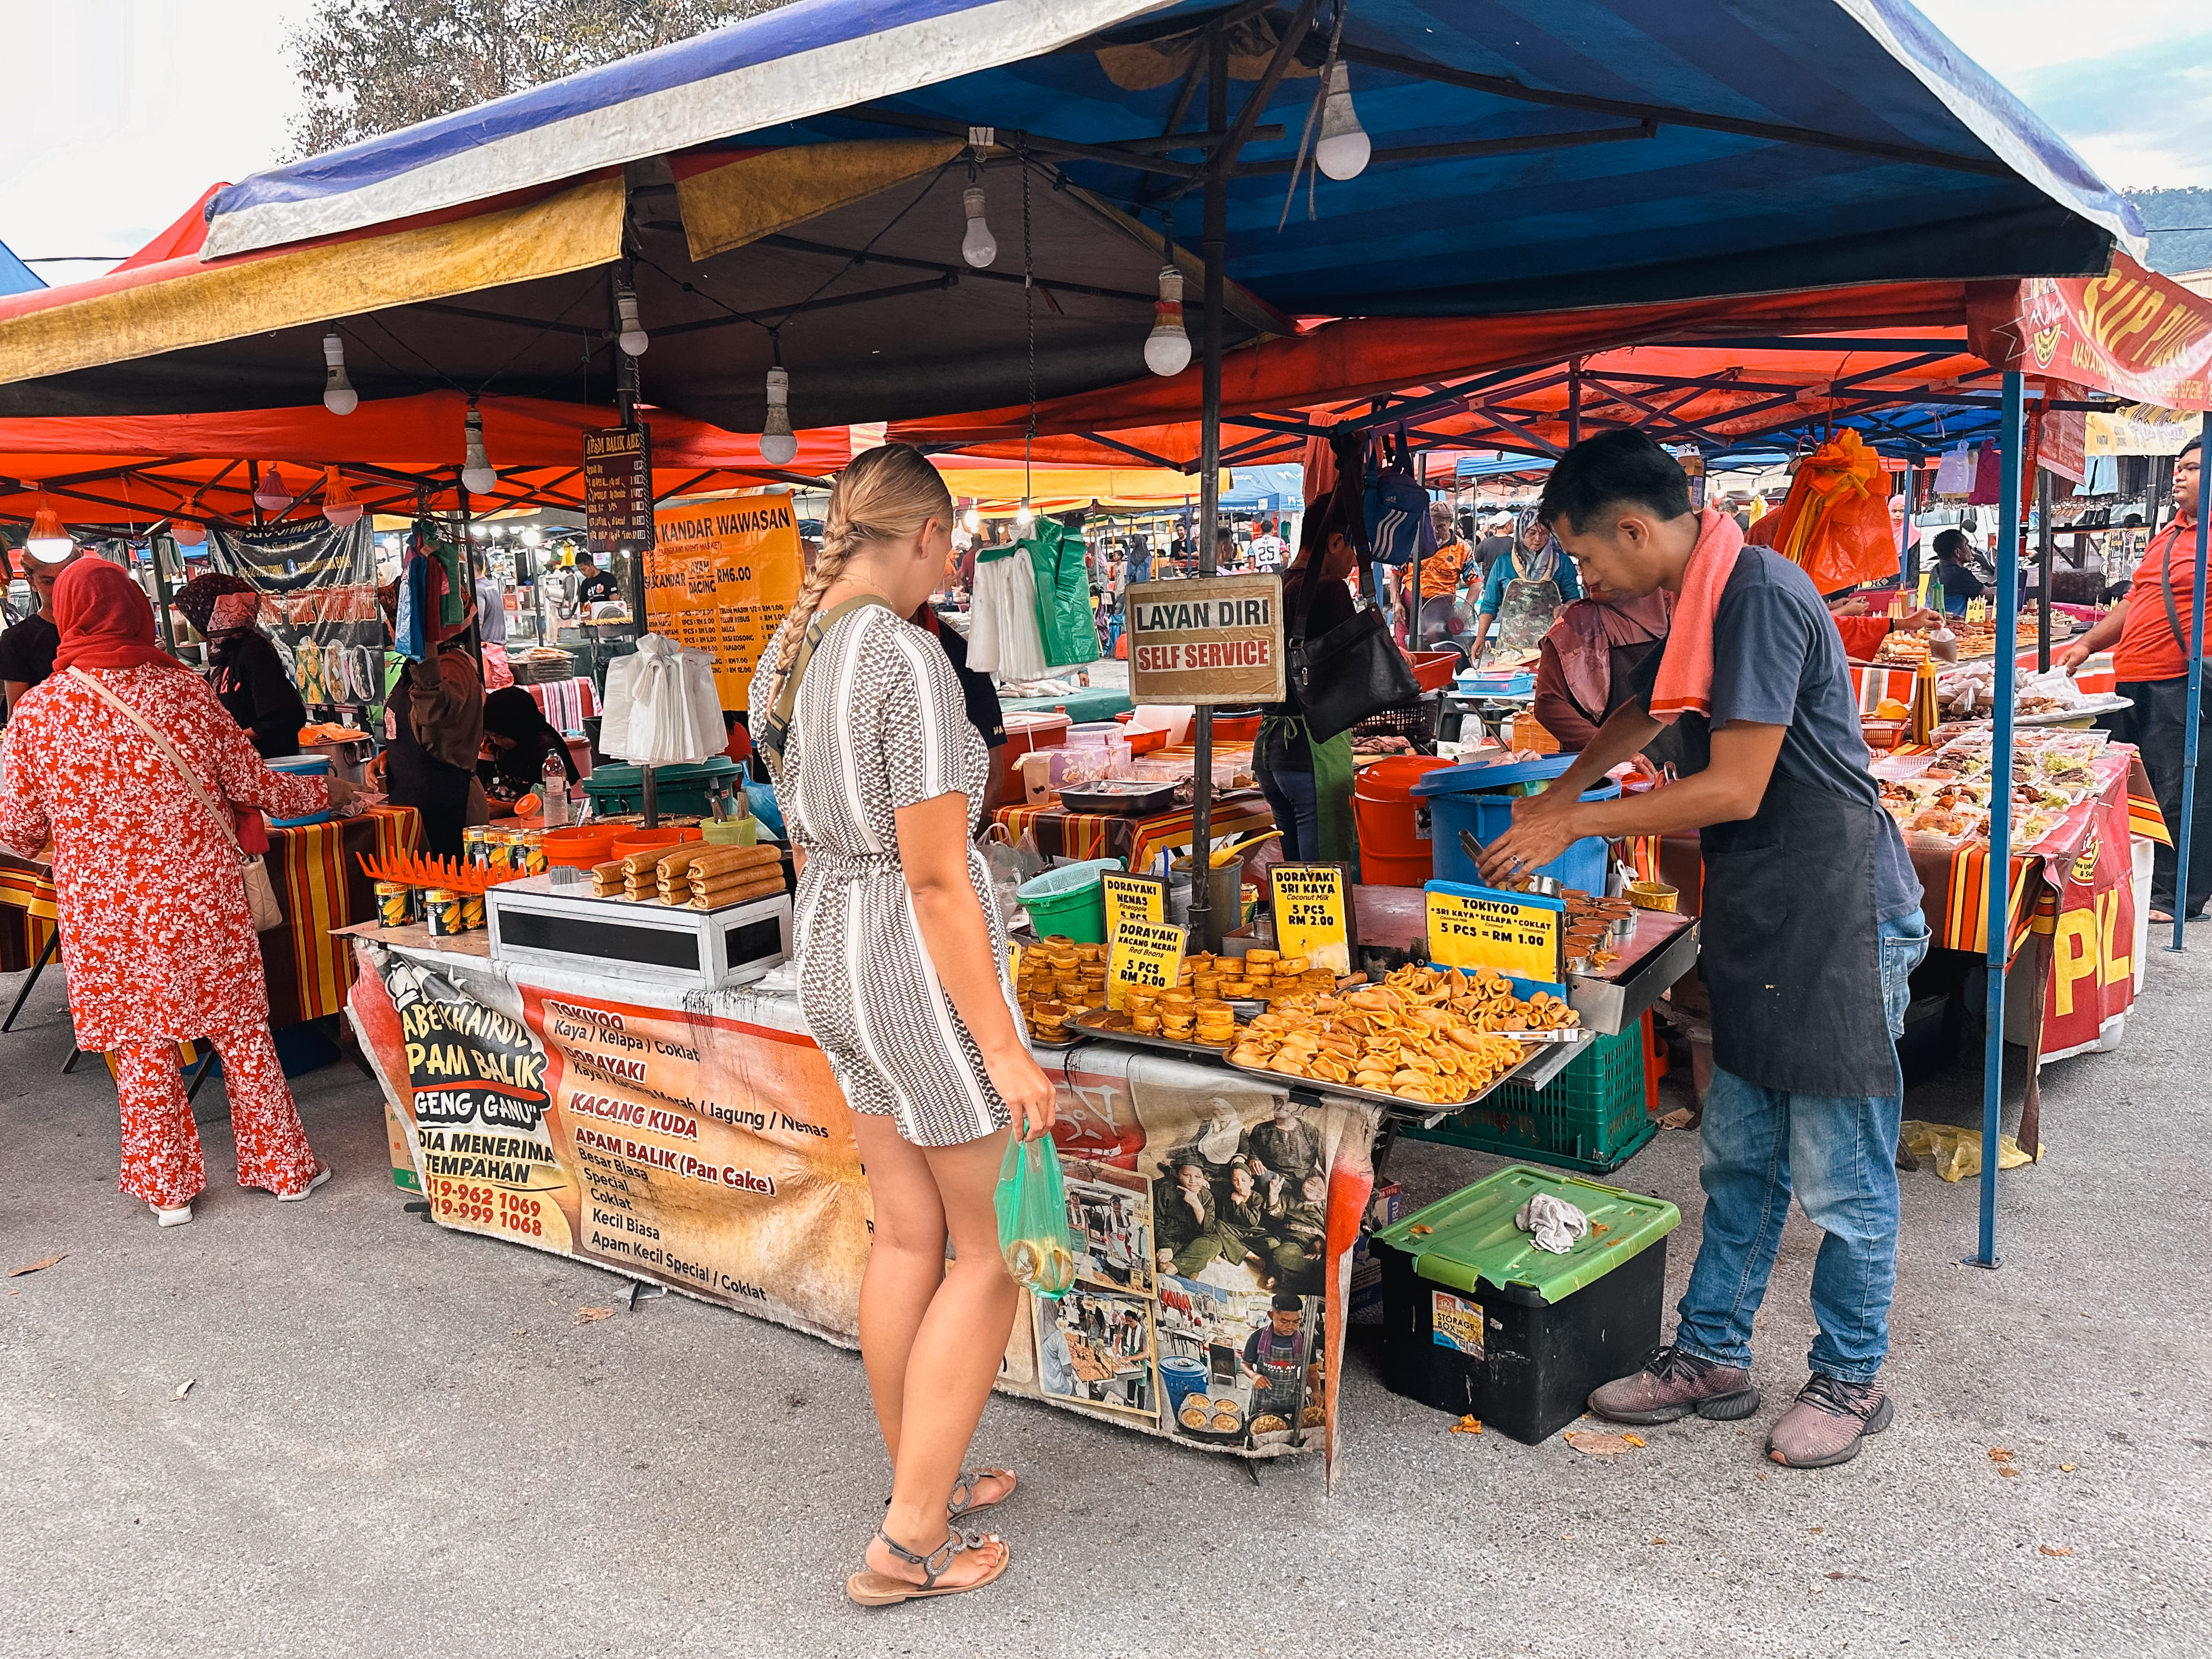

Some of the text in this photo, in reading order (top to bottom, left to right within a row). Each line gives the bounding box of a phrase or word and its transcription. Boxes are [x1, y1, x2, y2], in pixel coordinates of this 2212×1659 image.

[587, 438, 604, 455] APAM
[606, 435, 625, 452] BALIK
[661, 518, 714, 543] KANDAR
[716, 507, 791, 535] WAWASAN
[1258, 546, 1275, 561] 25
[690, 560, 710, 575] AYAM
[717, 566, 751, 583] RM6.00
[688, 580, 717, 594] DAGING
[1137, 599, 1269, 630] LAYAN DIRI
[1138, 641, 1269, 671] SELF SERVICE
[1108, 880, 1156, 895] DORAYAKI
[1276, 872, 1334, 882] DORAYAKI
[1117, 894, 1148, 906] NENAS
[1281, 884, 1335, 894] SRI KAYA
[1119, 903, 1147, 912] Pineapple
[1293, 904, 1325, 914] 5 PCS
[1462, 899, 1519, 916] TOKIYOO
[1289, 915, 1334, 926] RM 2.00
[1452, 910, 1475, 919] KAYA
[1480, 914, 1512, 924] KELAPA
[1519, 920, 1551, 930] COKLAT
[1118, 936, 1177, 952] KACANG MERAH
[1120, 923, 1178, 942] DORAYAKI
[1441, 923, 1448, 933] 5
[1454, 924, 1477, 937] PCS
[1492, 930, 1512, 942] RM
[1518, 934, 1544, 946] 1.00
[1143, 950, 1165, 958] Beans
[1120, 969, 1165, 987] RM 2.00
[1127, 959, 1159, 975] 5 PCS
[402, 1004, 528, 1048] ABE KHAIRUL
[551, 1001, 625, 1031] TOKIYOO
[555, 1019, 587, 1041] Kaya
[599, 1027, 644, 1052] Kelapa
[655, 1041, 701, 1063] Coklat
[470, 1049, 543, 1089] BALIK
[563, 1045, 646, 1081] DORAYAKI
[414, 1091, 473, 1116] GENG
[573, 1060, 603, 1081] Kaya
[709, 1101, 765, 1129] Jagung
[782, 1114, 829, 1139] Nenas
[570, 1092, 697, 1138] KACANG KUDA
[418, 1130, 557, 1163] DIA MENERIMA
[426, 1154, 531, 1183] TEMPAHAN
[575, 1128, 776, 1195] APAM BALIK (Pan Cake)
[579, 1147, 649, 1181] Besar Biasa
[584, 1168, 629, 1192] Special
[426, 1175, 541, 1217] 019-962 1069
[590, 1188, 632, 1211] Coklat
[500, 1211, 542, 1237] 1068
[592, 1208, 660, 1240] Kecil Biasa
[591, 1231, 630, 1256] Apam
[633, 1244, 663, 1265] Kecil
[666, 1253, 710, 1283] Special
[721, 1274, 768, 1301] Coklat
[1437, 1312, 1475, 1331] STORAGE
[1438, 1321, 1456, 1332] BOX
